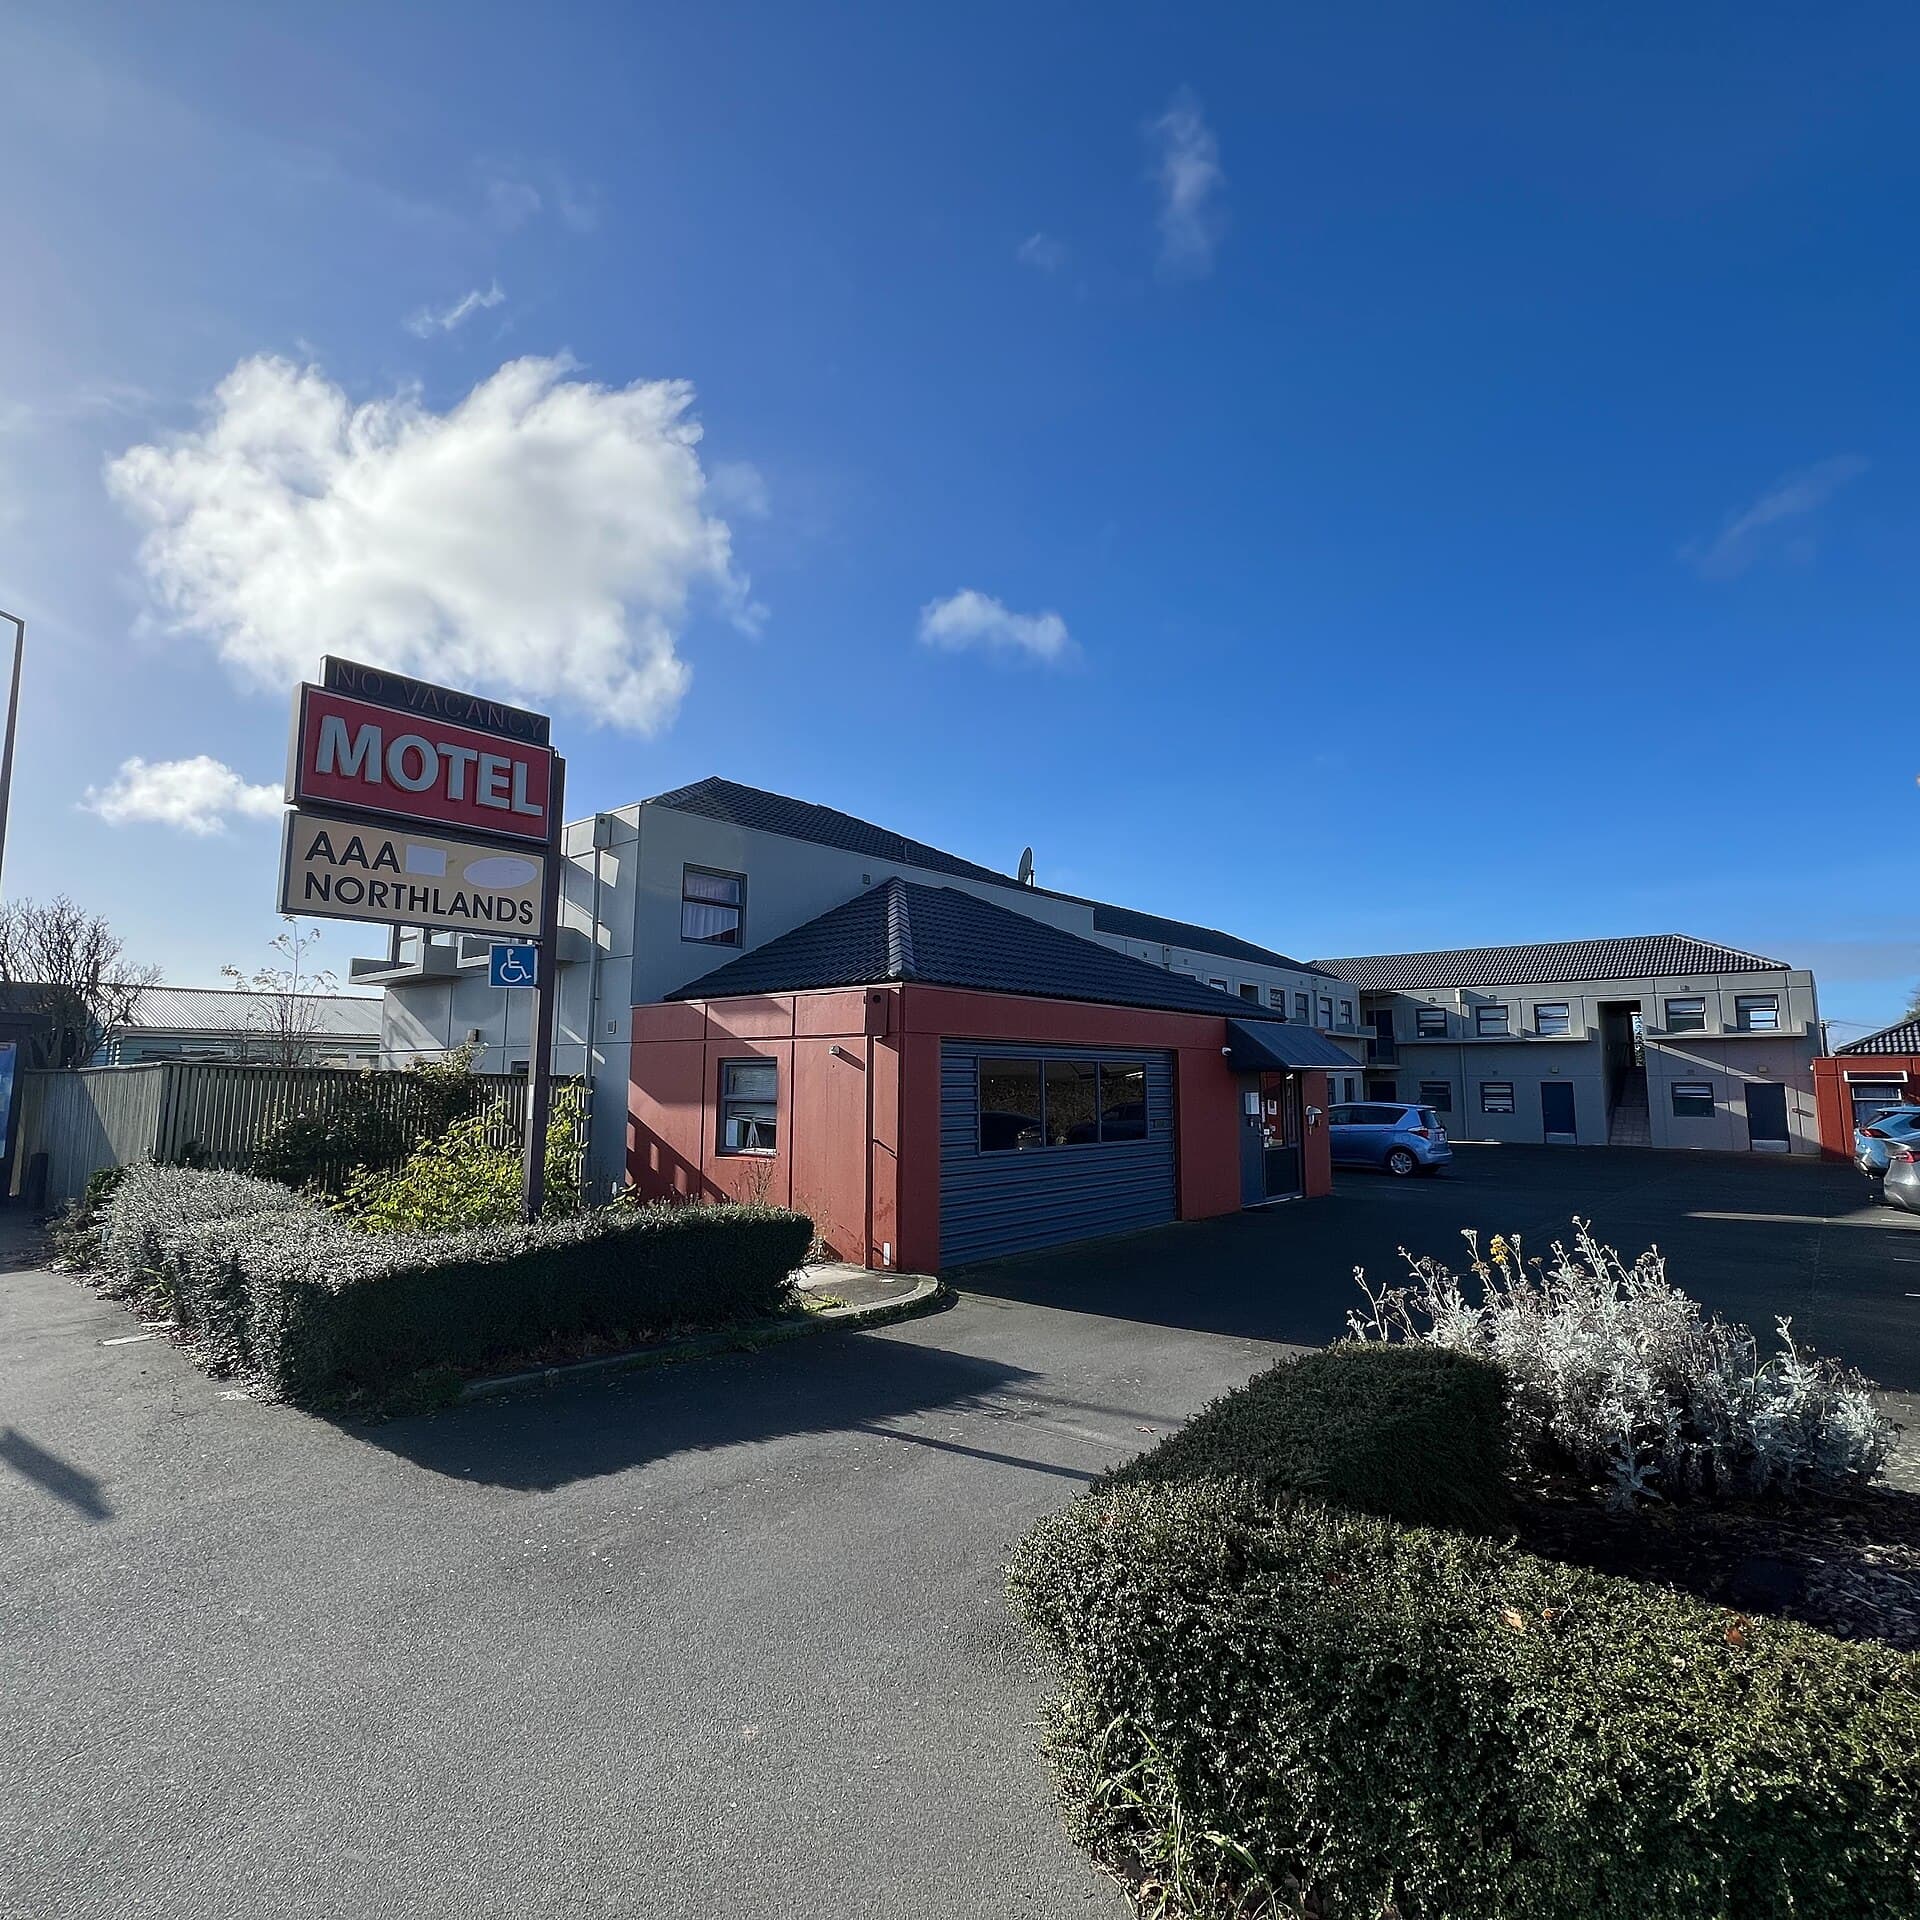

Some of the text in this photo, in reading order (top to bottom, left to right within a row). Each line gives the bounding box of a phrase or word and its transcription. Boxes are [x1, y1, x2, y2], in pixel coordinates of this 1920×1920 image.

[335, 664, 544, 737] NO VACANCY
[315, 715, 543, 816] MOTEL
[304, 831, 401, 873] AAA
[304, 872, 534, 924] NORTHLANDS
